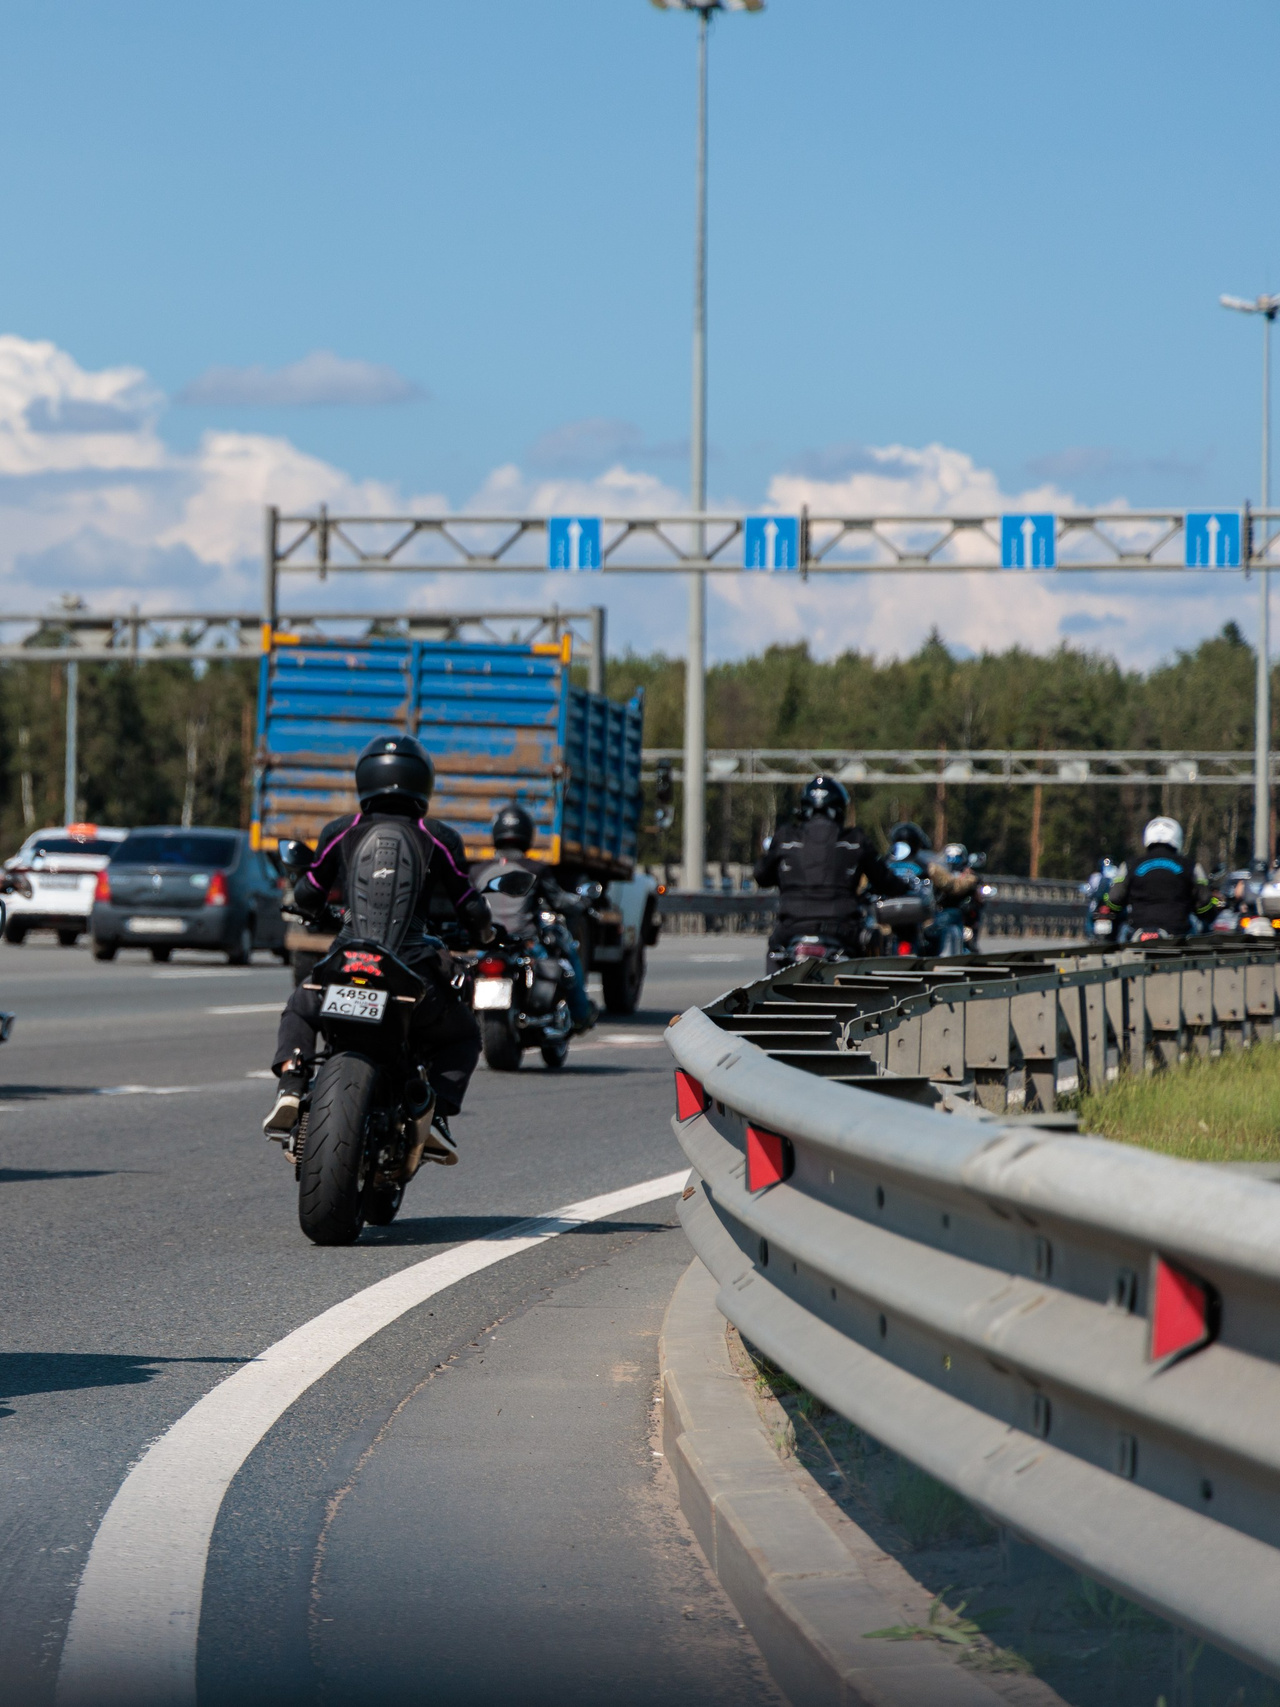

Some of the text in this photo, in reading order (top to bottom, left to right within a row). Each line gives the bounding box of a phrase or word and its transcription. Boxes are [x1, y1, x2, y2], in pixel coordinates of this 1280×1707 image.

[336, 988, 378, 1001] 4850
[327, 1002, 352, 1013] AC
[360, 1005, 378, 1017] 78
